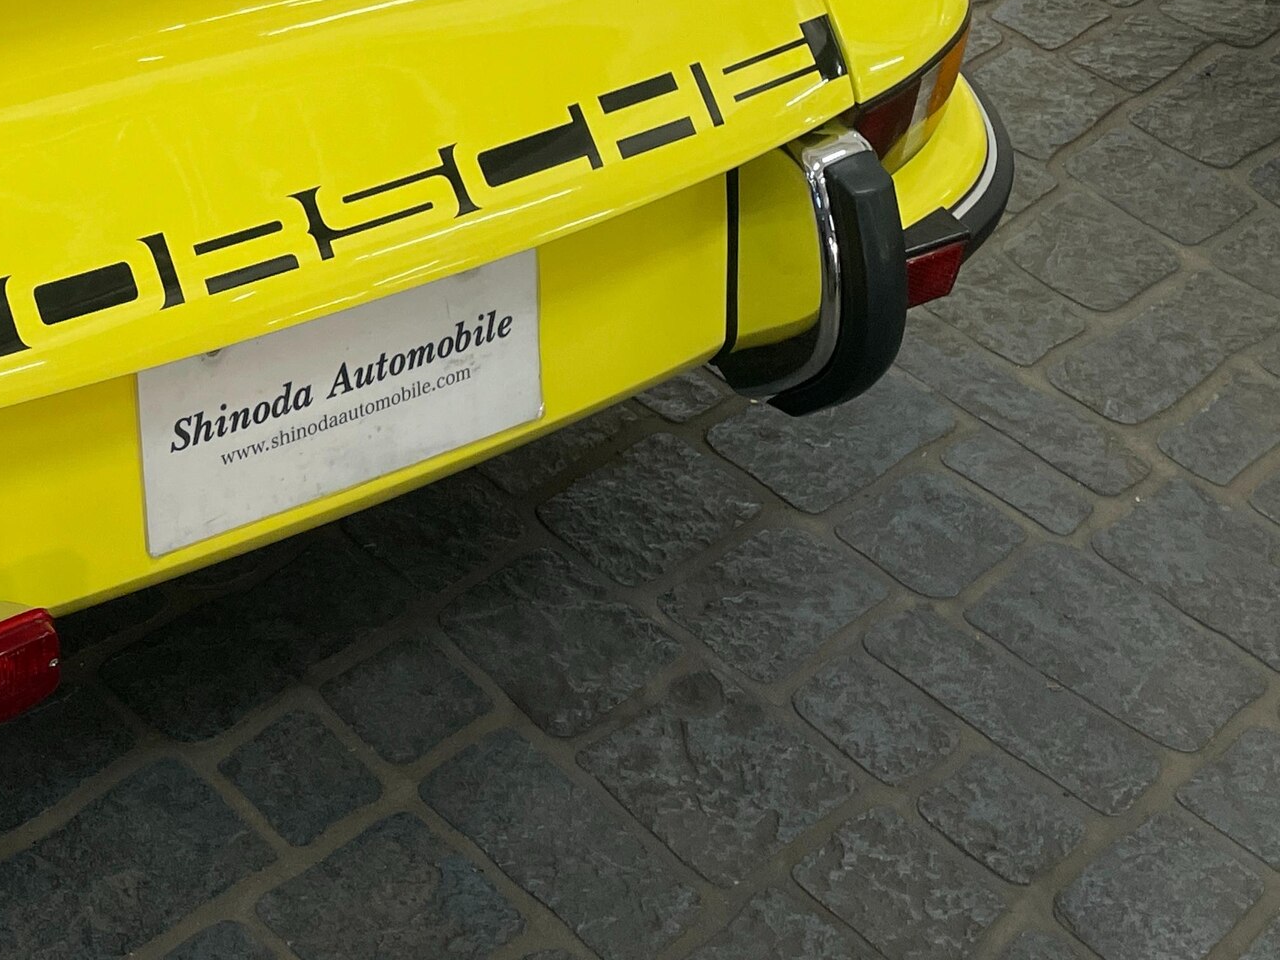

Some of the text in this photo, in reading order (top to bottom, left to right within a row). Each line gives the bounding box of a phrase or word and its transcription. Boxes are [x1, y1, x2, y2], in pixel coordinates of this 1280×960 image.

[169, 308, 514, 454] Shinoda Automobile
[220, 364, 472, 466] www.shinodaautomobile.com
